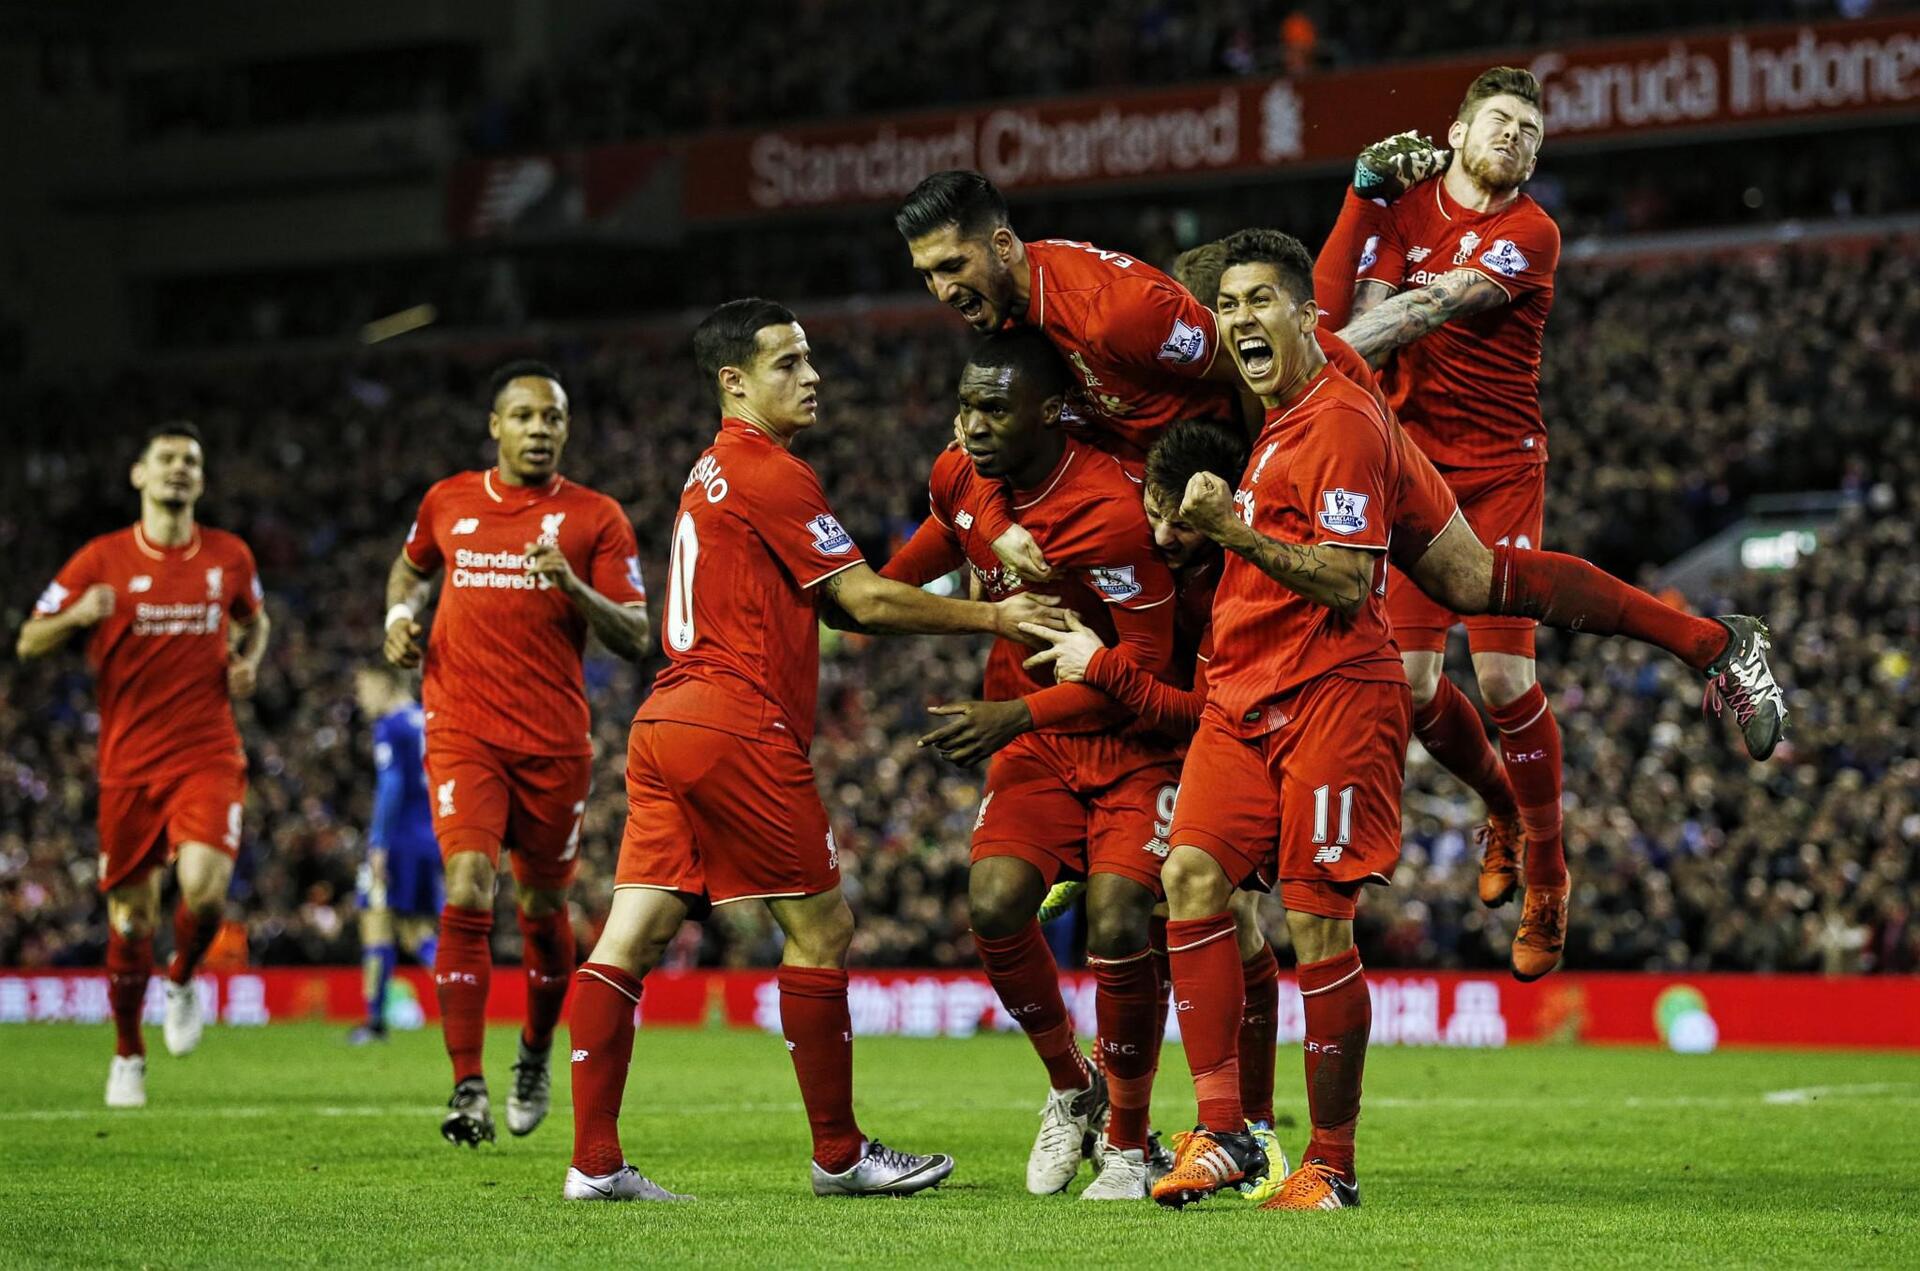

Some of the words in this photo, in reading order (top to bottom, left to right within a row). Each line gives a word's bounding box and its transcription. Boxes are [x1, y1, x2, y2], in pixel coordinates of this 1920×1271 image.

[1529, 41, 1719, 133] Garuda
[750, 114, 976, 206] Standard
[979, 87, 1240, 185] Chartered
[1312, 784, 1353, 845] 11
